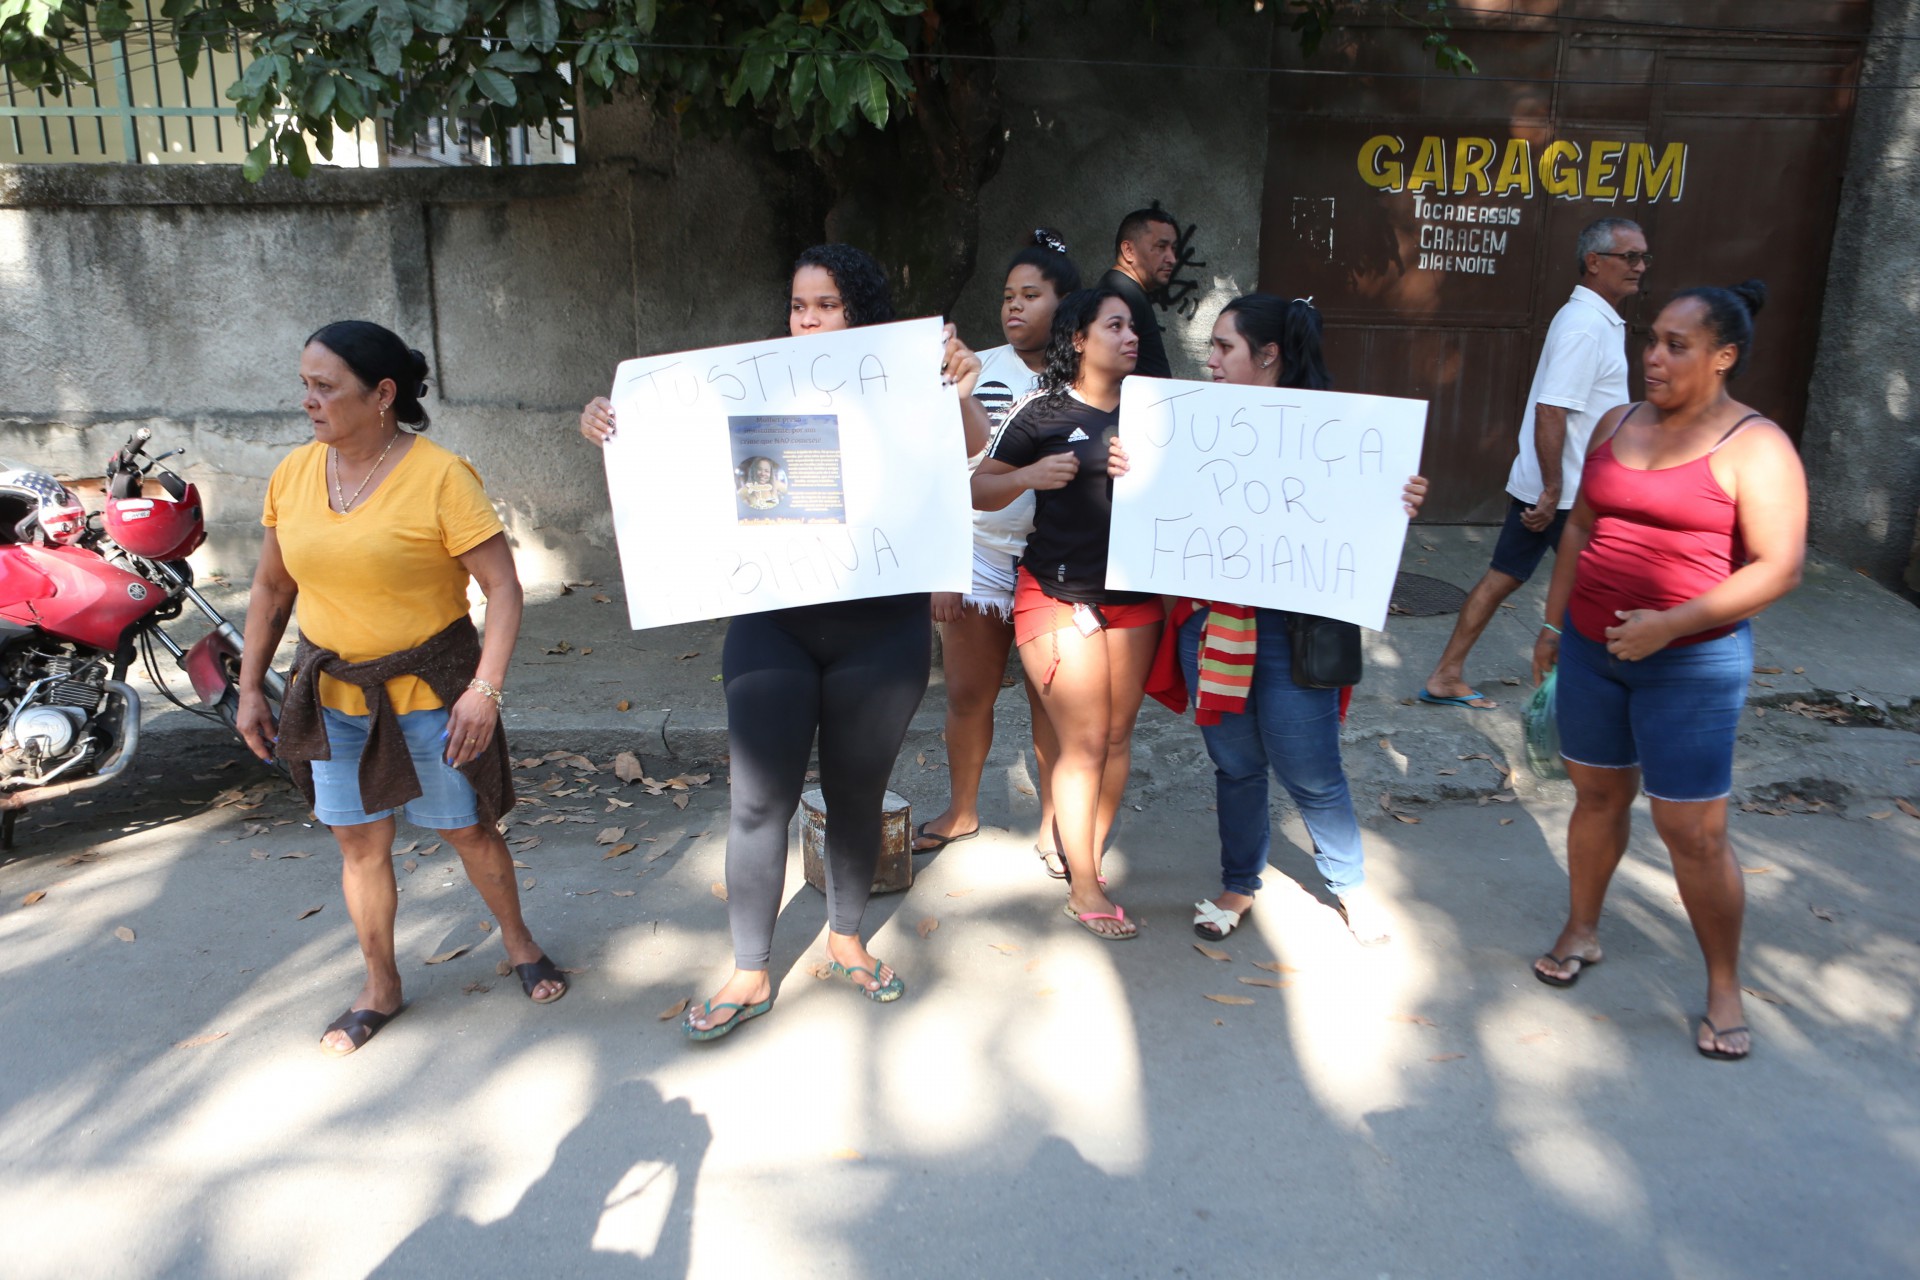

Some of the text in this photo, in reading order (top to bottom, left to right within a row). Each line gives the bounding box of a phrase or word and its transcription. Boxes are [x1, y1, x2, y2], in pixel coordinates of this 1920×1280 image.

[1357, 135, 1688, 208] GARAGEM
[1197, 458, 1326, 523] POR
[1151, 513, 1356, 600] FABIANA
